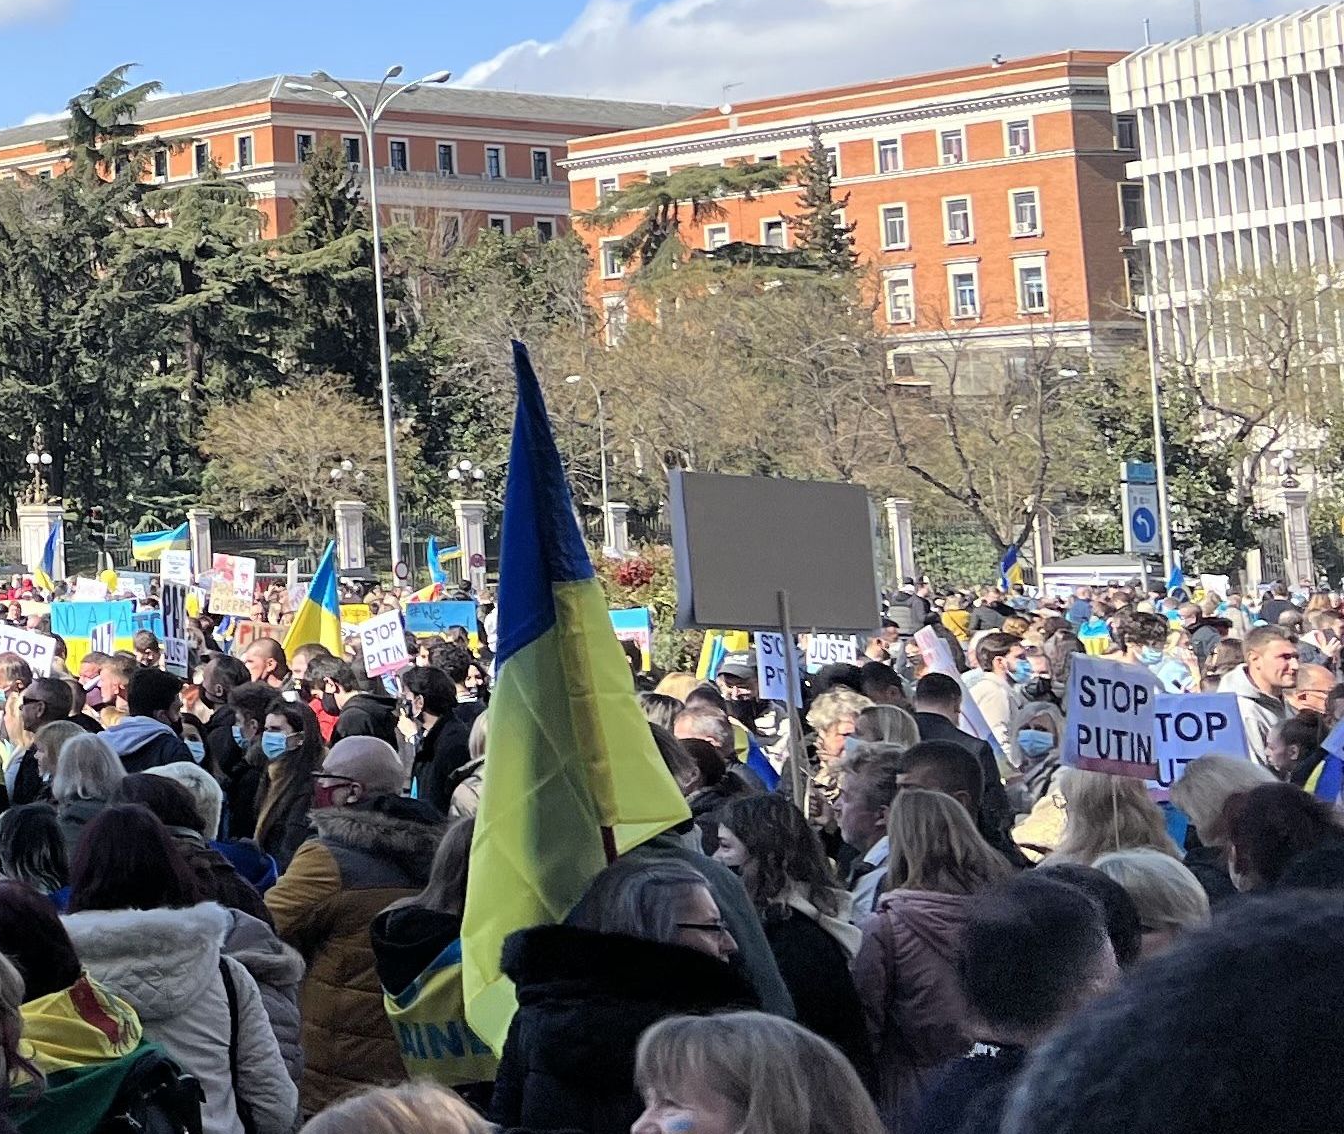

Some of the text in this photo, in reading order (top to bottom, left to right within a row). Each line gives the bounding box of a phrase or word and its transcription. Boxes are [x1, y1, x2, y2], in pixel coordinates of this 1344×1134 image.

[56, 606, 76, 634] NO
[364, 621, 397, 646] STOP
[810, 640, 853, 662] JUSTA
[1080, 675, 1148, 715] STOP
[1155, 712, 1228, 741] TOP
[1077, 724, 1152, 765] PUTIN
